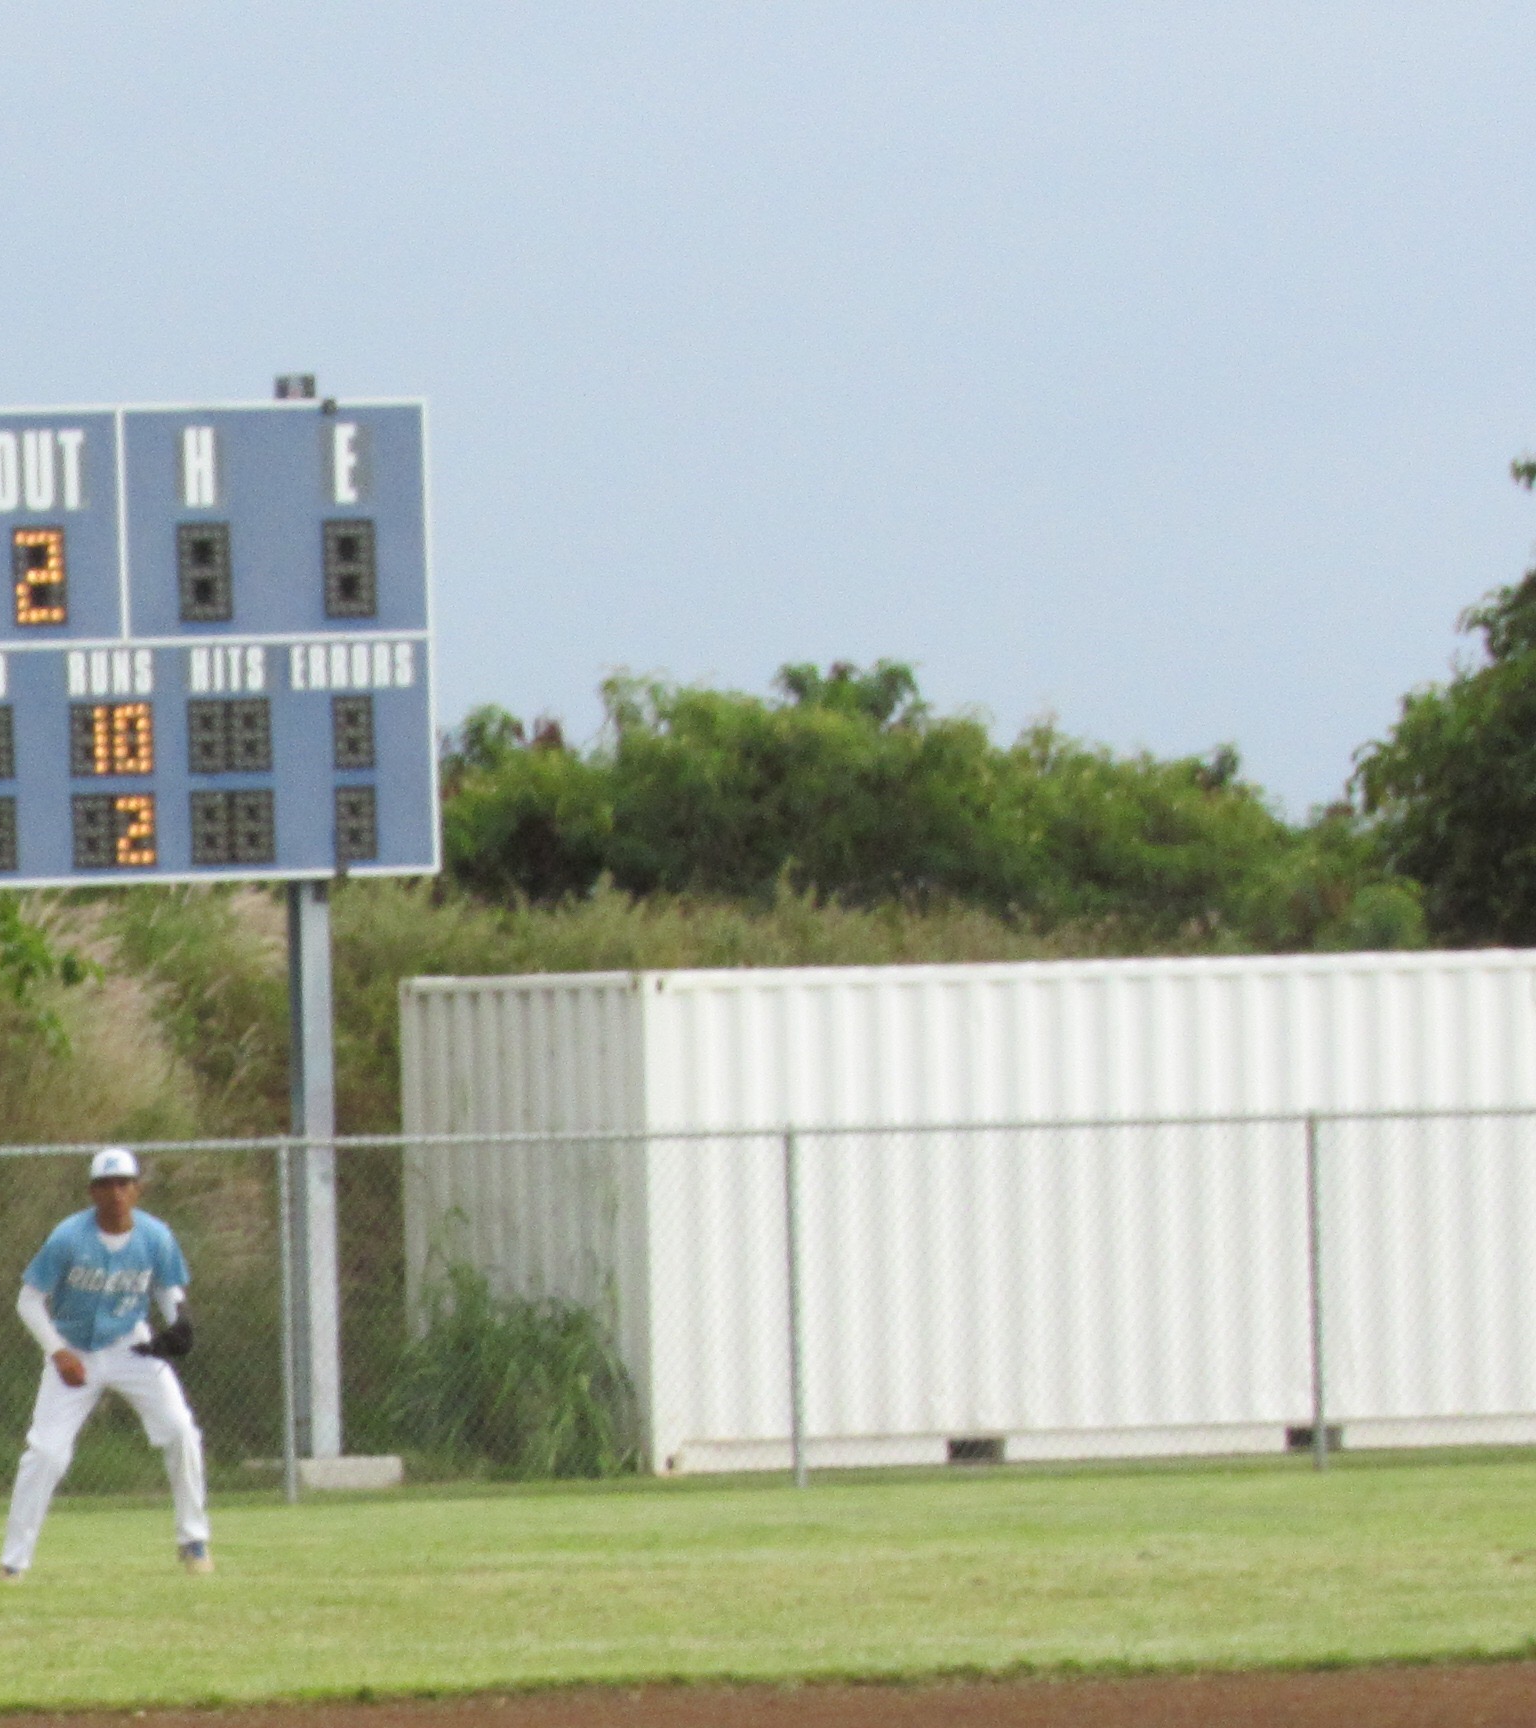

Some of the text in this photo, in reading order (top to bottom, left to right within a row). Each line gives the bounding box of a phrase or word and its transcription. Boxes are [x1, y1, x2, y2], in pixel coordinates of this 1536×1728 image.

[183, 426, 216, 507] H
[333, 423, 359, 503] E
[14, 530, 66, 625] 2
[68, 648, 153, 696] RUNS
[190, 646, 265, 692] HITS
[290, 642, 414, 691] ERRORS
[93, 703, 153, 775] 10
[115, 796, 157, 866] 2
